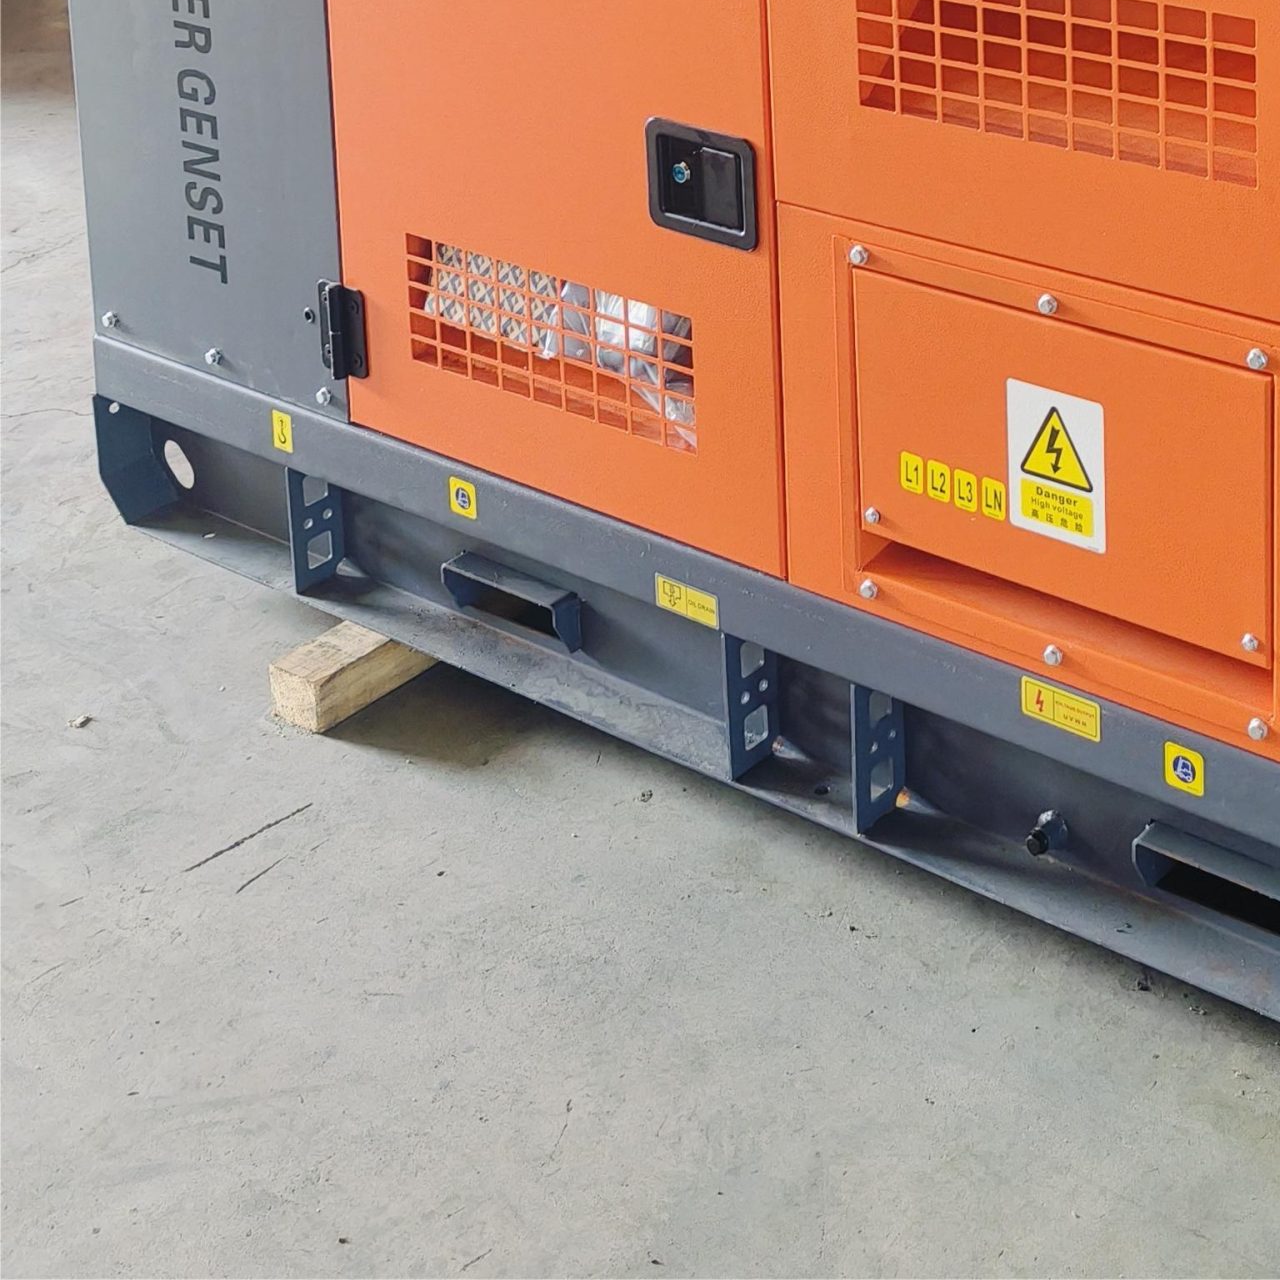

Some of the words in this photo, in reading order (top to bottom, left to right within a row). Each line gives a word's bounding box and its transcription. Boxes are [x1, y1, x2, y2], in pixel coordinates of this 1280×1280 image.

[176, 68, 229, 285] GENSET
[905, 460, 919, 486] L1
[931, 468, 946, 494] L2
[957, 476, 973, 503] L3
[985, 488, 1002, 513] LN
[1036, 486, 1078, 507] Danger
[1031, 496, 1051, 509] High
[1052, 503, 1084, 520] voltage
